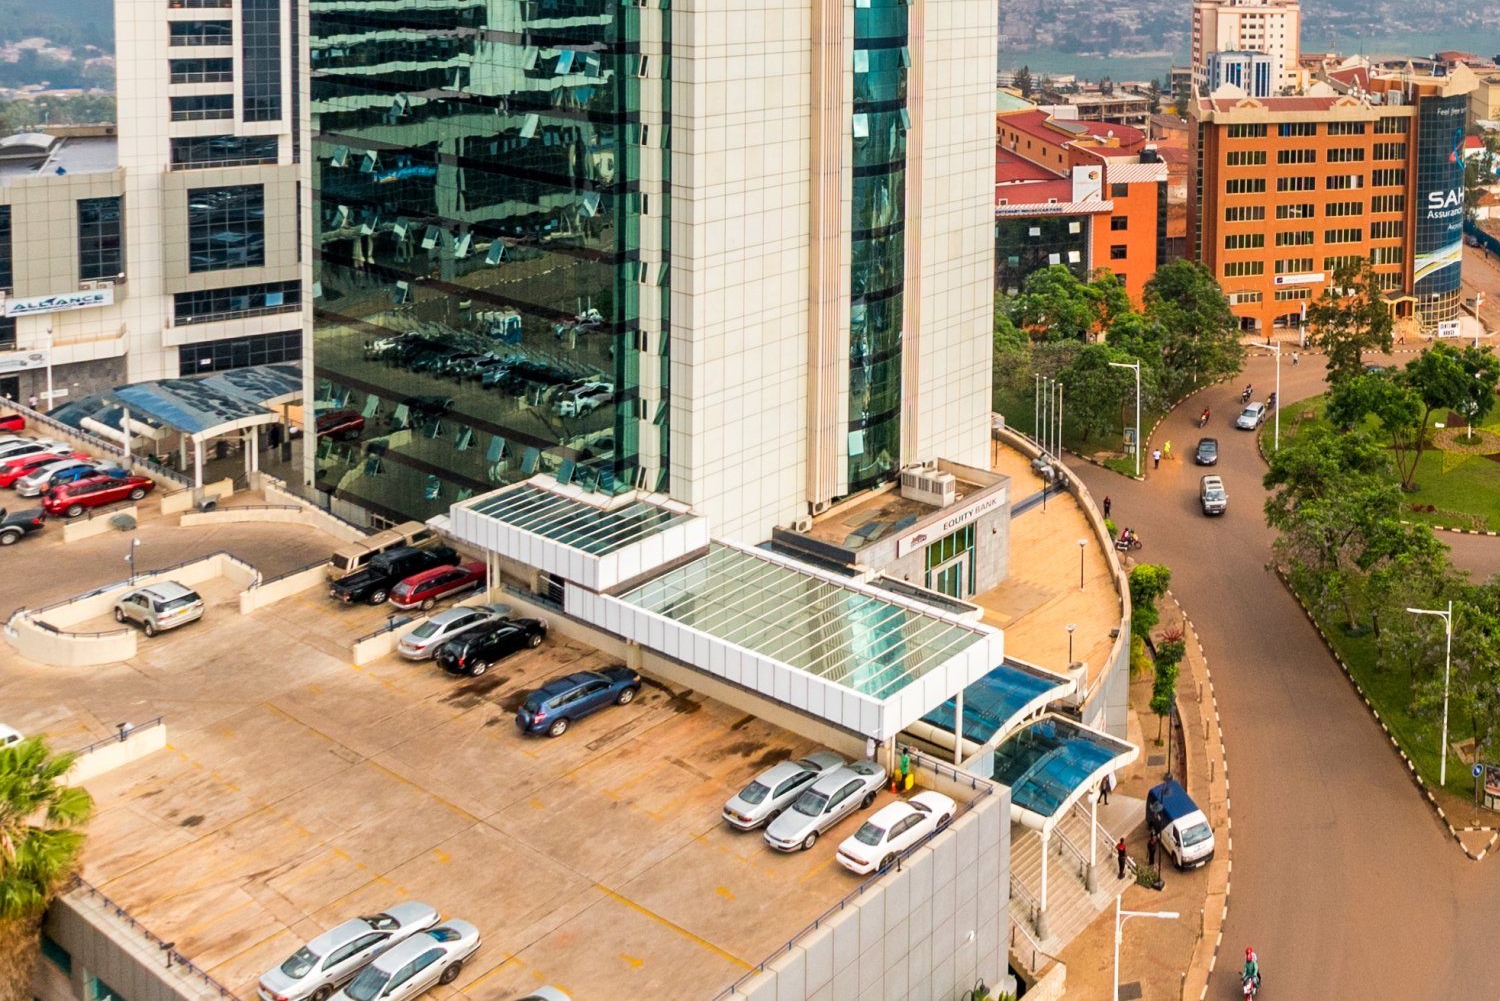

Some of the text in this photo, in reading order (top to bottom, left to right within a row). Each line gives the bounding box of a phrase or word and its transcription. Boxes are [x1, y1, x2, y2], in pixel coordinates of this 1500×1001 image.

[1428, 186, 1465, 210] SAH
[1427, 206, 1463, 219] Assuranc
[943, 498, 997, 531] EQUITY BANK
